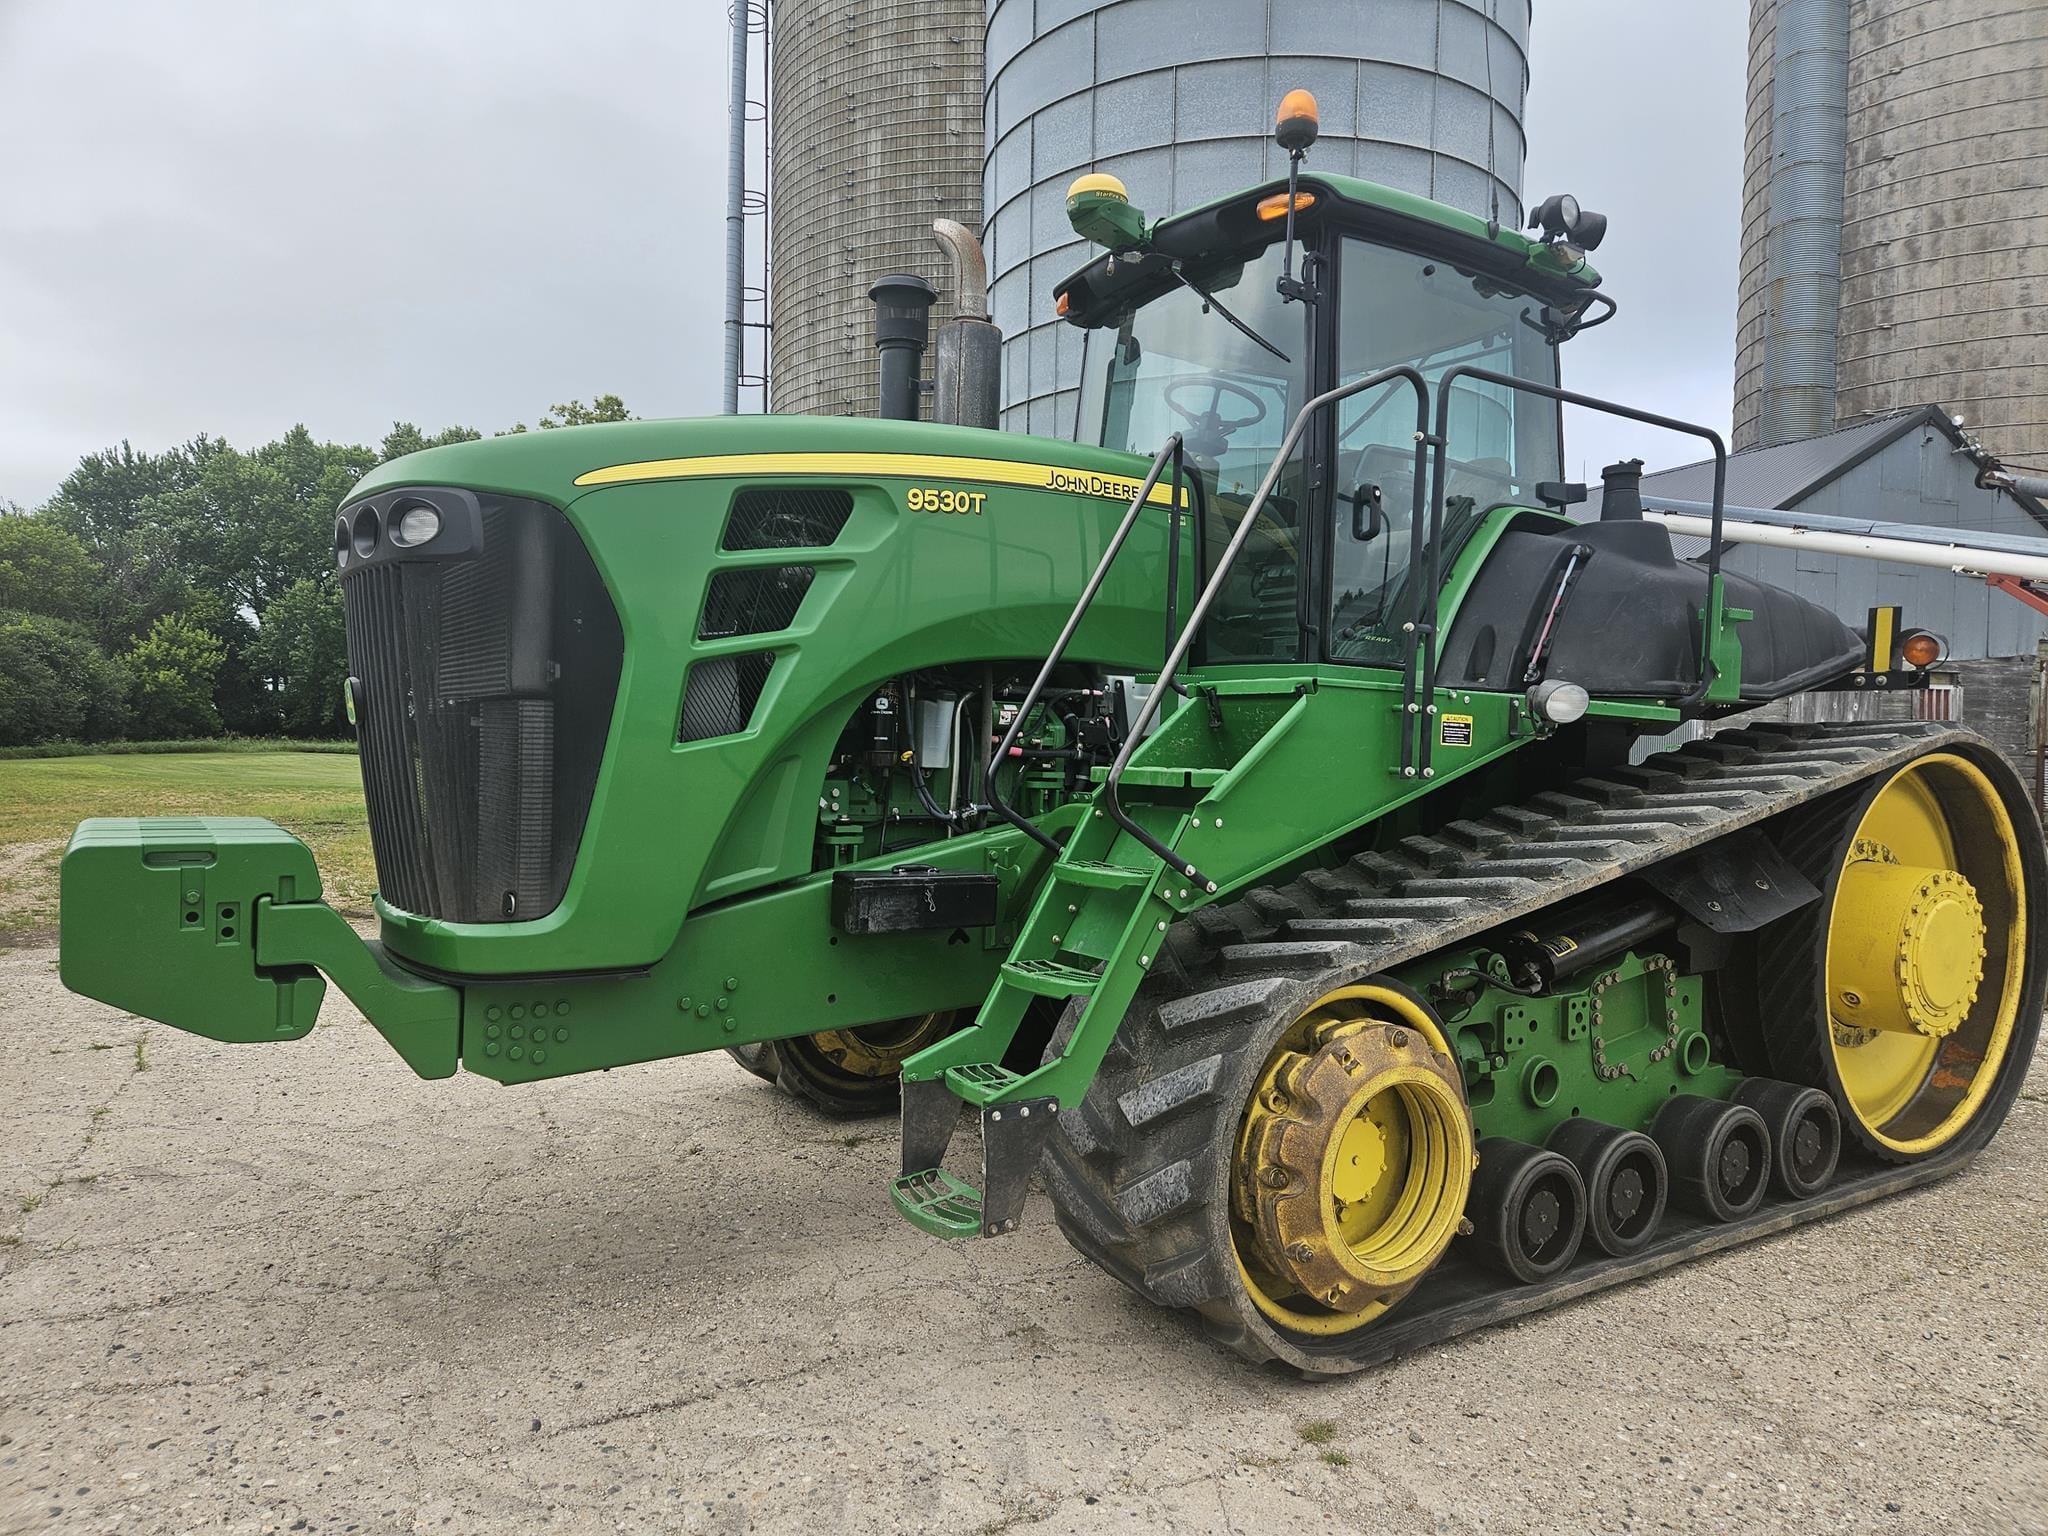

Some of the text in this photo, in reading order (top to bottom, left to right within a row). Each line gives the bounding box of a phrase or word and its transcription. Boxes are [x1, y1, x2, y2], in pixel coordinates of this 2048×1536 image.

[1046, 470, 1140, 499] JOHN DEERE
[907, 487, 987, 515] 9530T
[1365, 635, 1392, 643] READY
